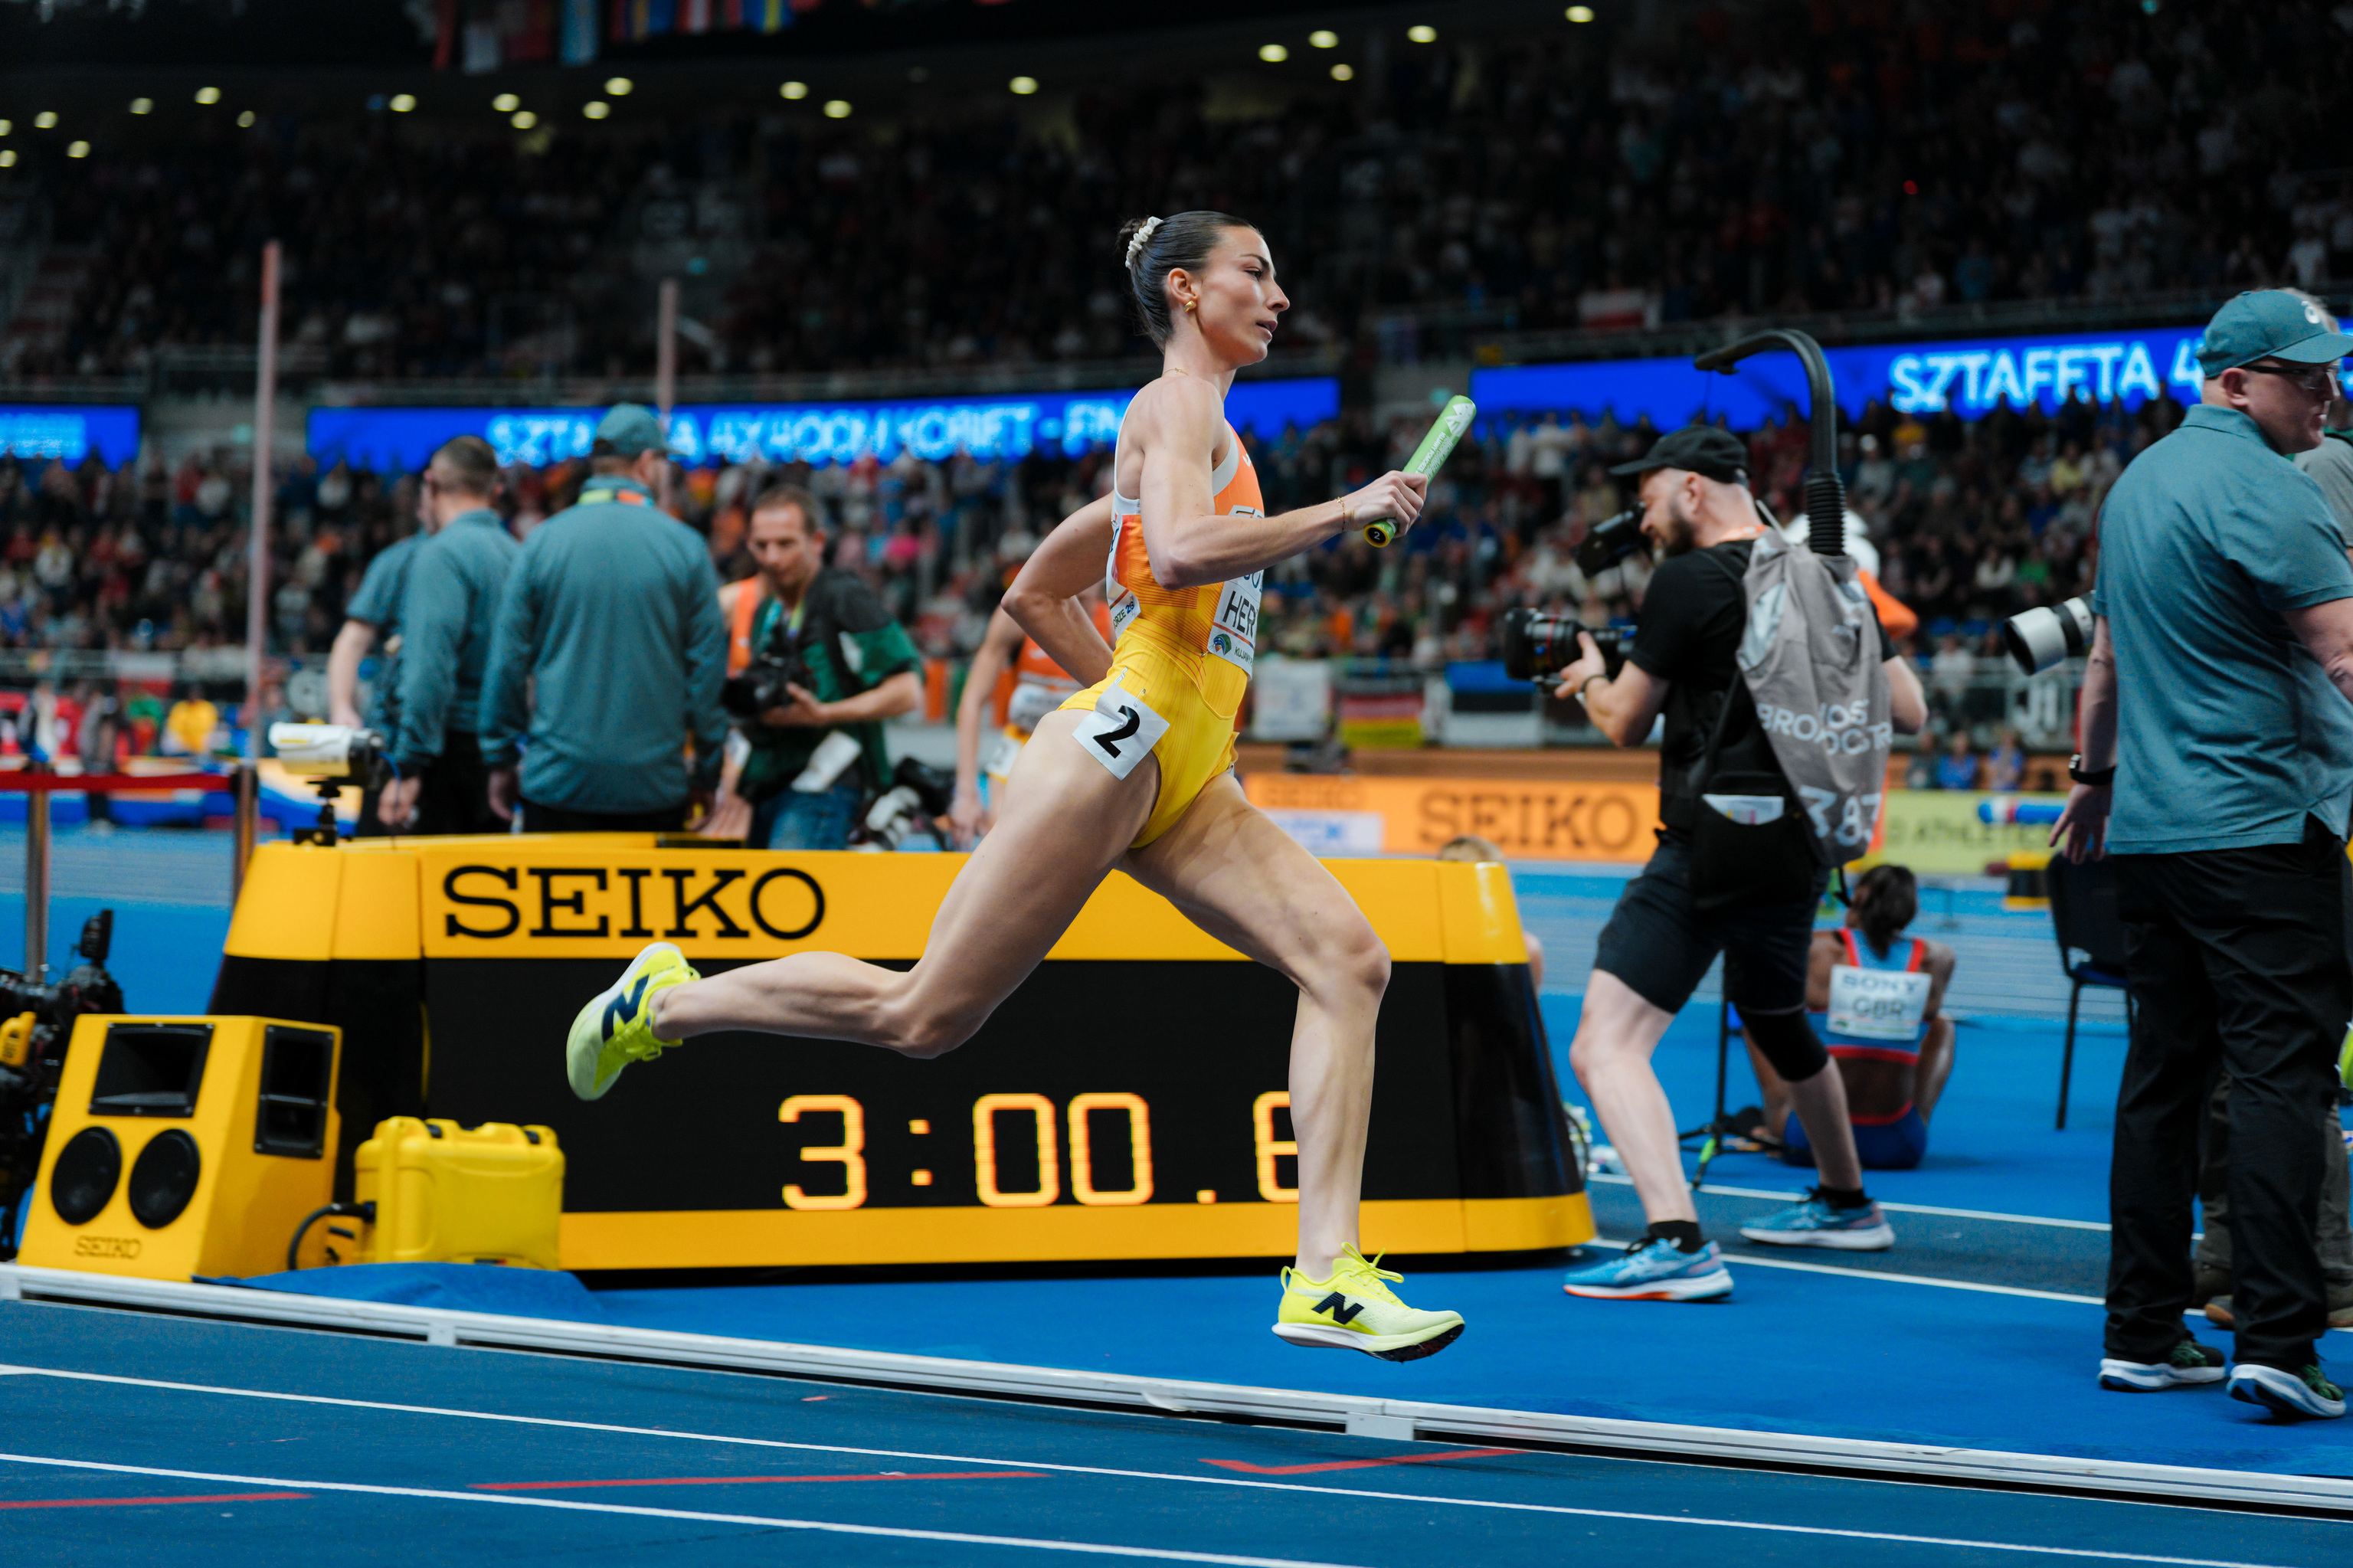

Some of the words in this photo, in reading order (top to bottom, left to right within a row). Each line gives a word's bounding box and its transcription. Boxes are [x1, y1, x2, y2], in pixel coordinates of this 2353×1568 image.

[1373, 531, 1380, 540] 2
[1111, 608, 1126, 630] ORZE
[1222, 590, 1258, 638] HER
[1093, 705, 1140, 758] 2
[1419, 791, 1638, 852] SEIKO
[443, 865, 825, 940] SEIKO
[1854, 996, 1904, 1020] GBR
[74, 1235, 141, 1260] SEIKO
